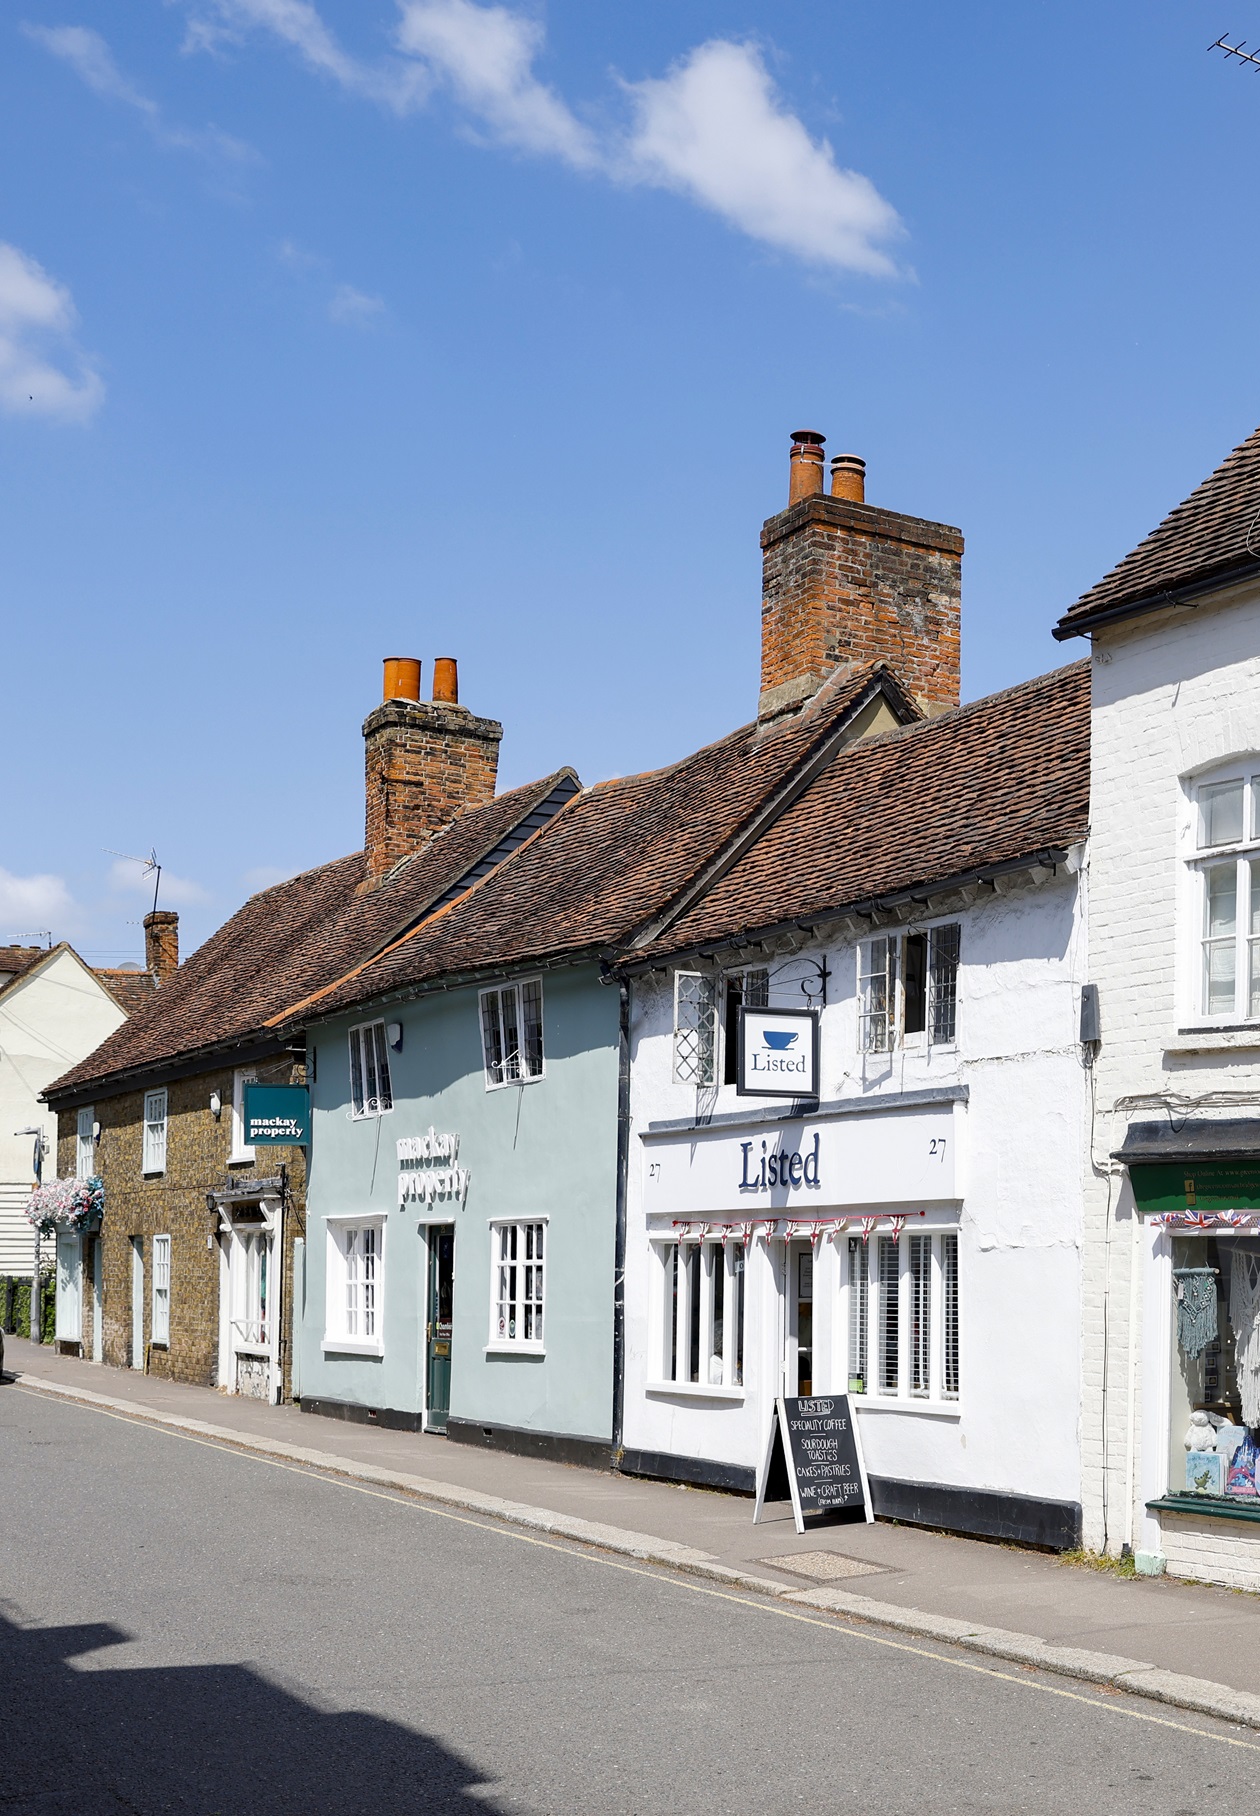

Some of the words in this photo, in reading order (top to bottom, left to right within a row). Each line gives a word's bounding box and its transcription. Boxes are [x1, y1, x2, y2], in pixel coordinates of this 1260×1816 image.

[751, 1053, 806, 1073] Listed
[250, 1116, 297, 1128] mackay
[250, 1127, 304, 1138] property
[396, 1125, 460, 1169] mackay
[929, 1138, 947, 1163] 27
[738, 1132, 821, 1189] Listed
[649, 1163, 661, 1183] 27
[1183, 1170, 1196, 1178] Shop
[398, 1160, 471, 1204] property
[798, 1399, 835, 1412] LISTED
[823, 1418, 847, 1431] COFFEE
[801, 1439, 838, 1449] SOURDOUGH
[807, 1450, 838, 1461] TOASTIES
[843, 1483, 859, 1494] BEER
